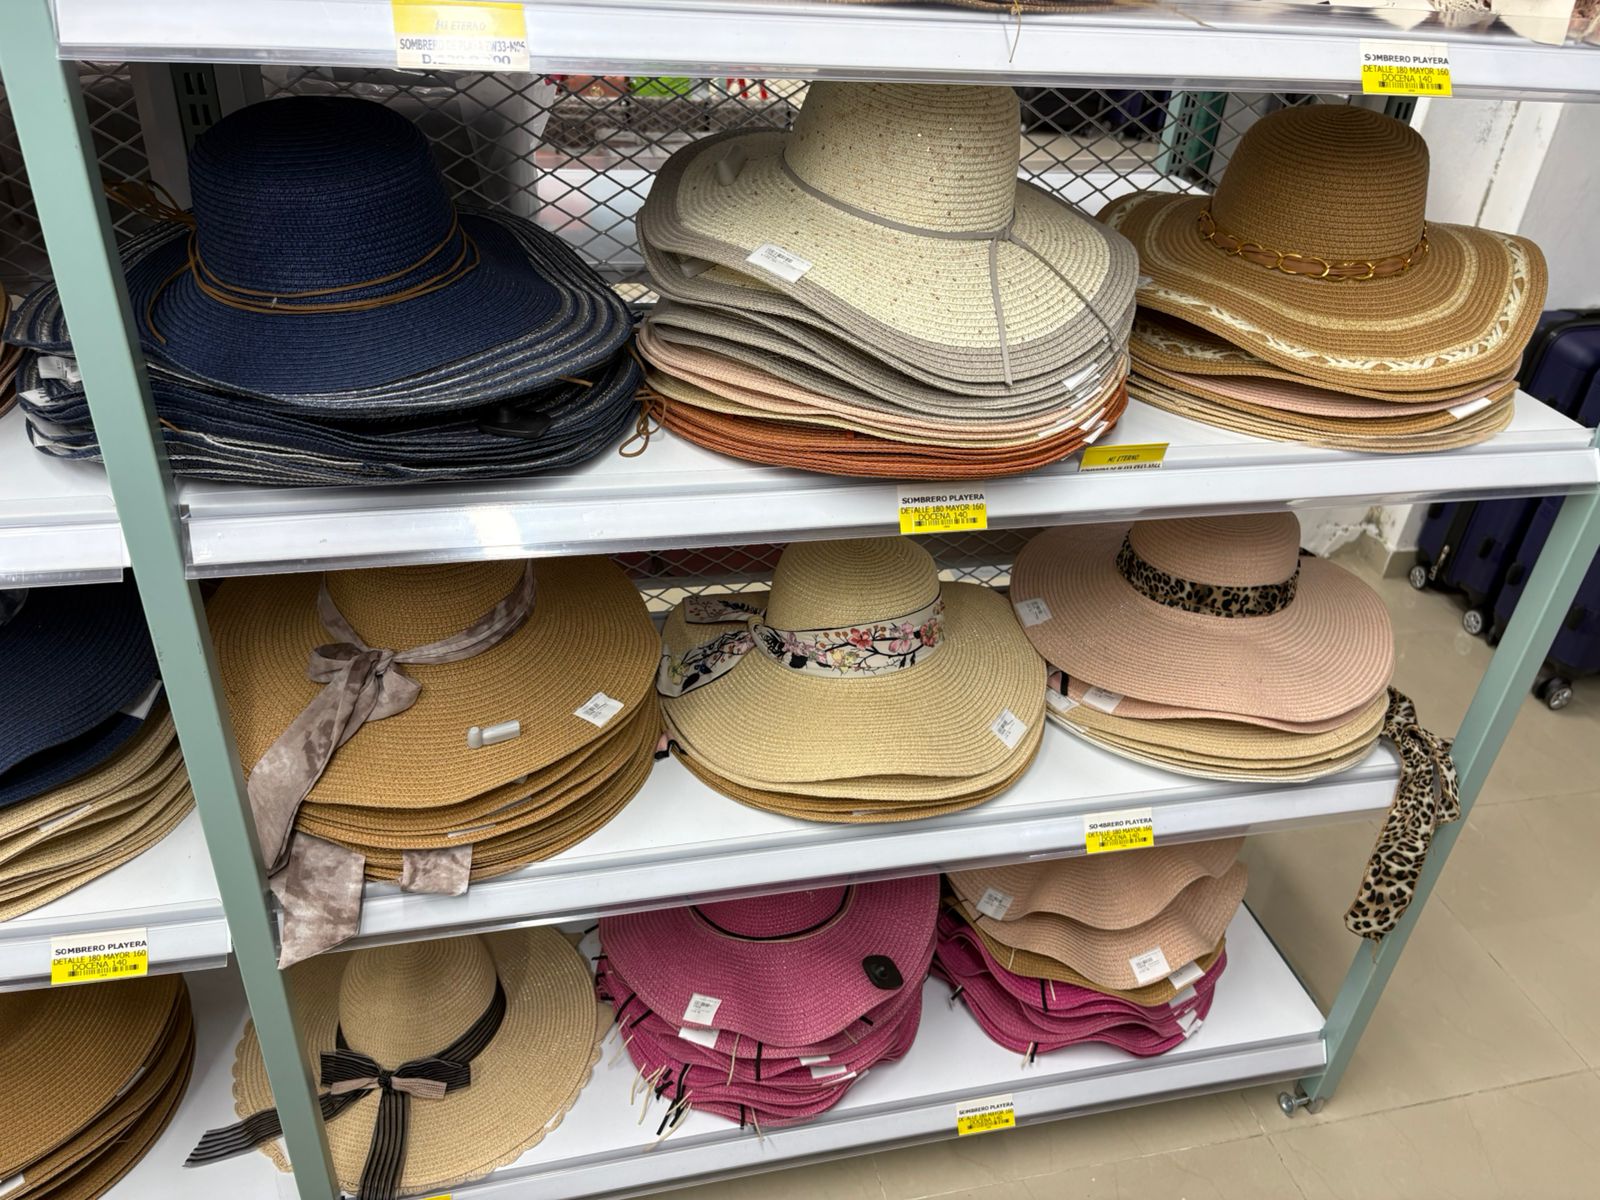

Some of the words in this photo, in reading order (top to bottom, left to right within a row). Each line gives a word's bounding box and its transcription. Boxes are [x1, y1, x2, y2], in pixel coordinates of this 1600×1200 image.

[1364, 53, 1411, 62] SOMBRERO
[1413, 56, 1449, 64] PLAYERA
[1363, 64, 1393, 73] DETALLE
[1396, 66, 1408, 74] 180
[1409, 67, 1435, 75] MAYOR
[1437, 68, 1449, 76] 160
[1382, 74, 1415, 82] DOCENA
[1419, 75, 1432, 83] 140
[902, 495, 947, 504] SOMBRERO
[949, 493, 985, 501] PLAYERA
[901, 505, 930, 514] DETALLE
[946, 503, 969, 512] MAYOR
[972, 503, 984, 511] 160
[918, 512, 950, 520] DOCENA
[954, 511, 967, 519] 140
[1125, 817, 1153, 825] PLAYERA
[55, 944, 105, 955] SOMBRERO
[108, 940, 147, 950] PLAYERA
[53, 956, 86, 966] DETALLE
[88, 954, 101, 962] 180
[104, 952, 130, 960] MAYOR
[133, 949, 146, 958] 160
[72, 961, 109, 971] DOCENA
[112, 959, 127, 967] 140
